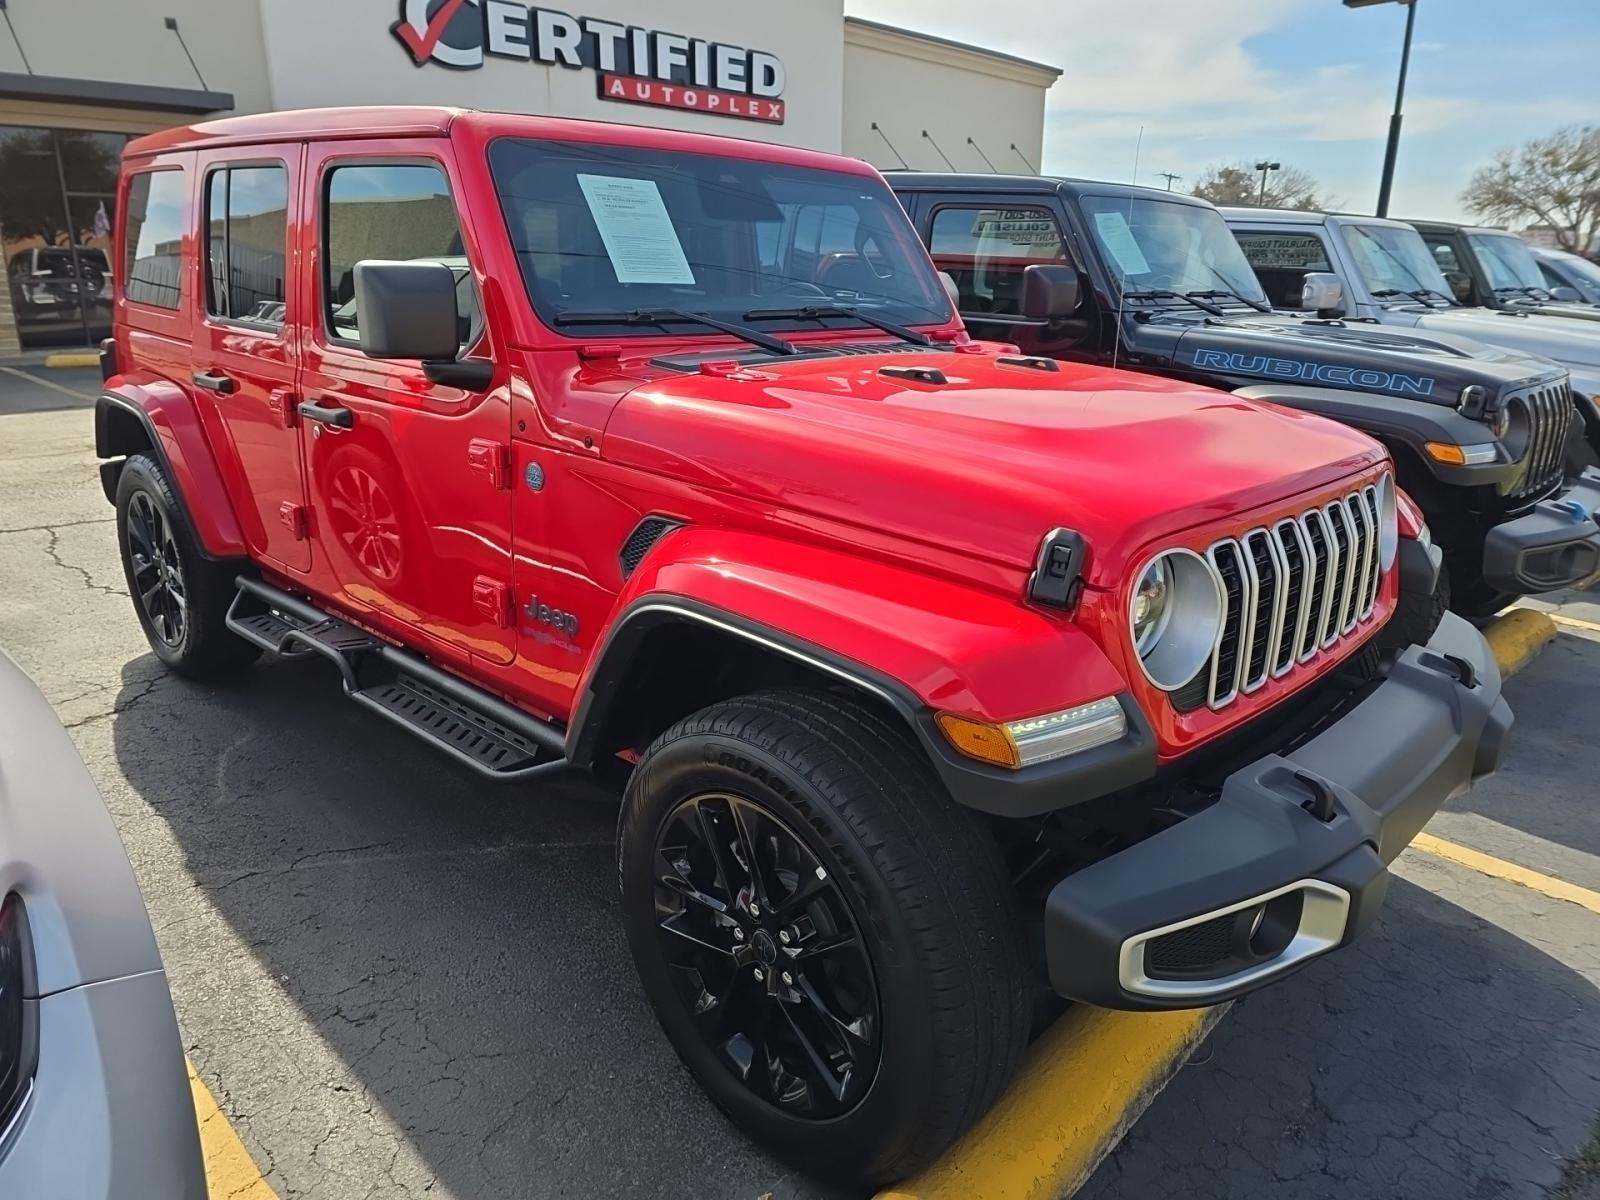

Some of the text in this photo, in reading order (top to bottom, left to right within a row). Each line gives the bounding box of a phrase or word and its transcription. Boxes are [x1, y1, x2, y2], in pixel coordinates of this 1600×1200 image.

[397, 0, 786, 98] CERTIFIED
[610, 79, 781, 119] AUTOPLEX
[1193, 349, 1434, 395] RUBICON
[523, 594, 578, 637] Jeep
